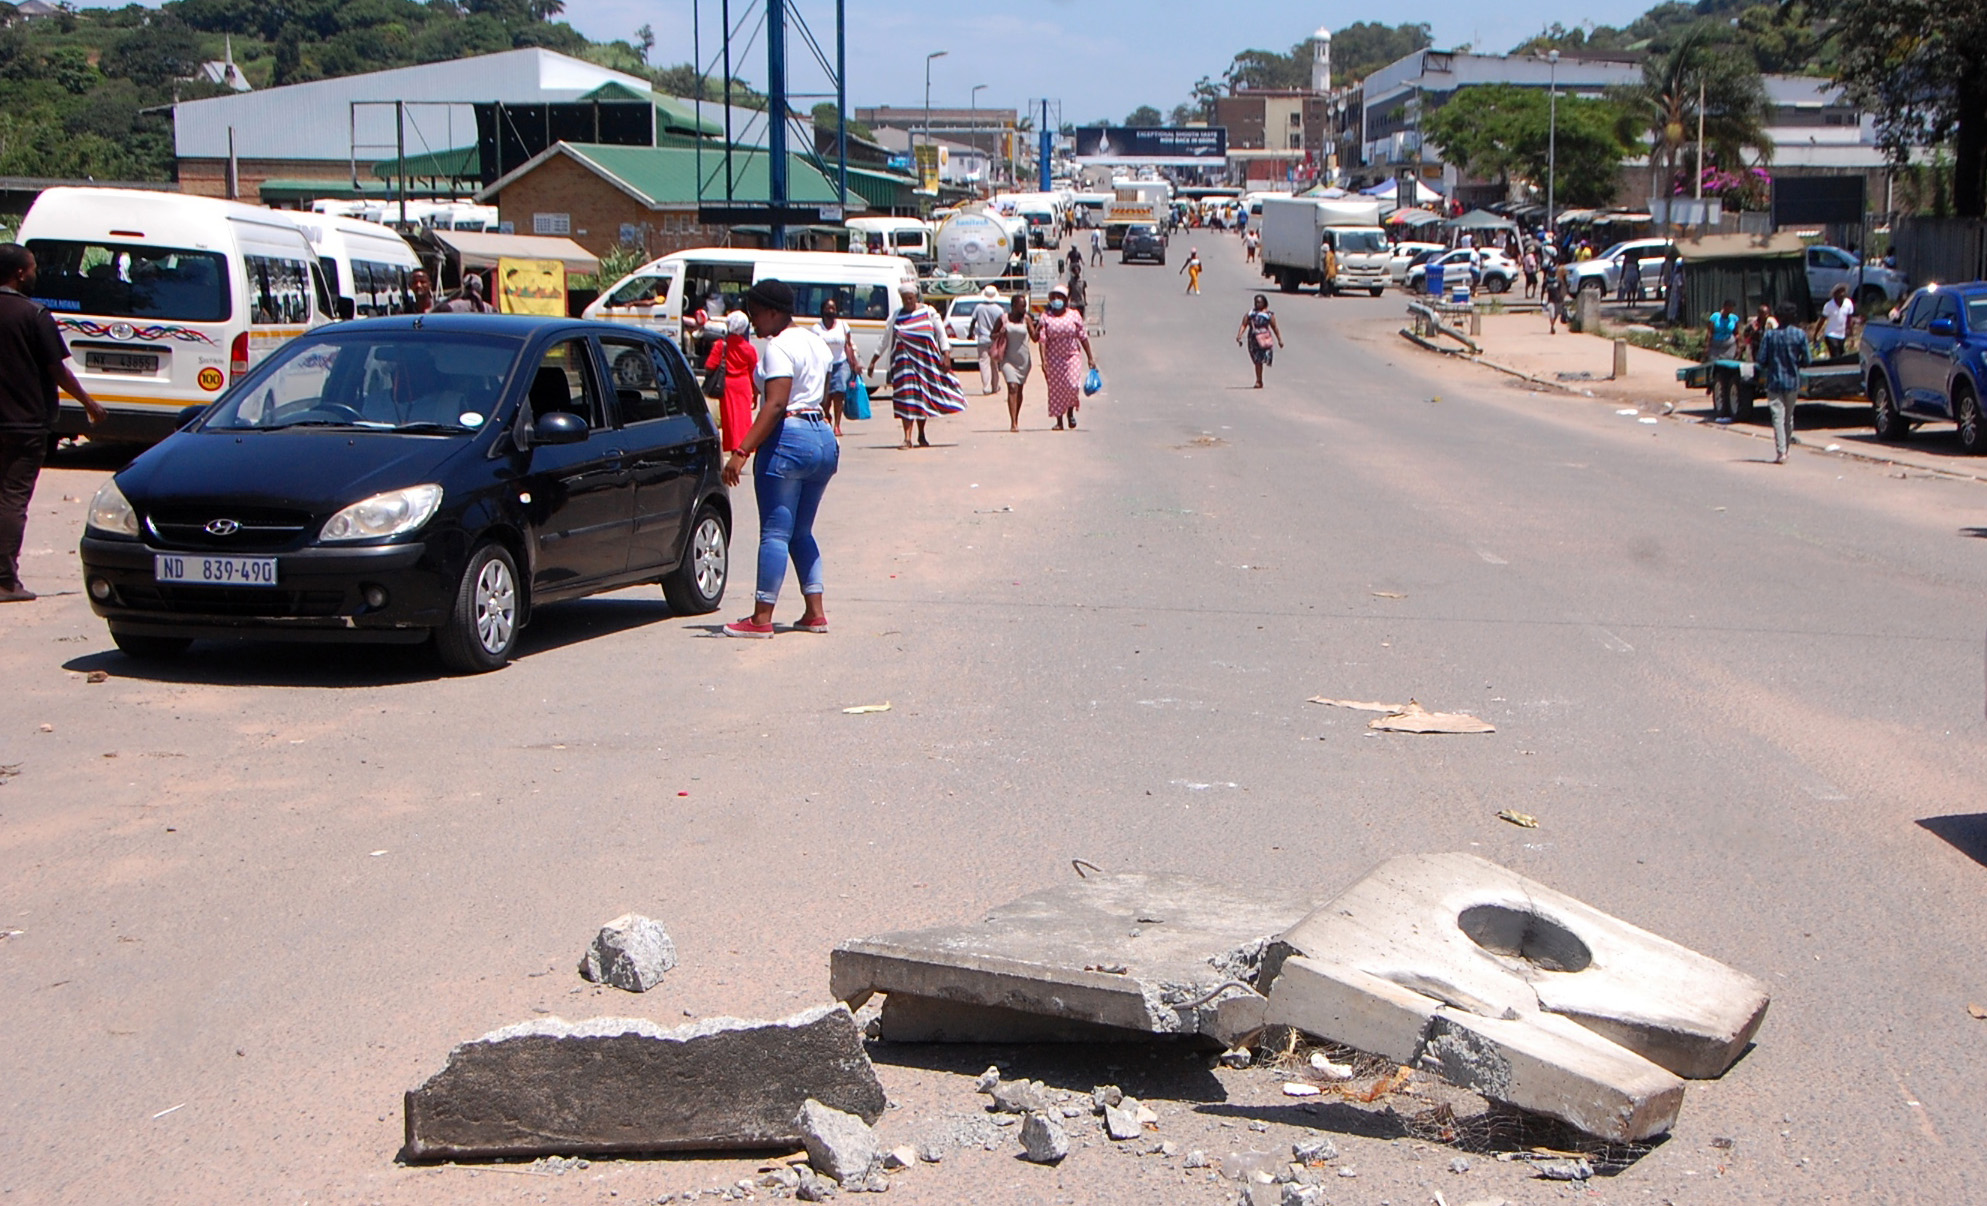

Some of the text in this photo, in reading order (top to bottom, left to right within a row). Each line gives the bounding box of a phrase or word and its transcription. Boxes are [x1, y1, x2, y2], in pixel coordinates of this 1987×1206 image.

[956, 218, 989, 226] Sanitech
[202, 373, 220, 385] 100
[164, 558, 272, 582] ND 839-490
